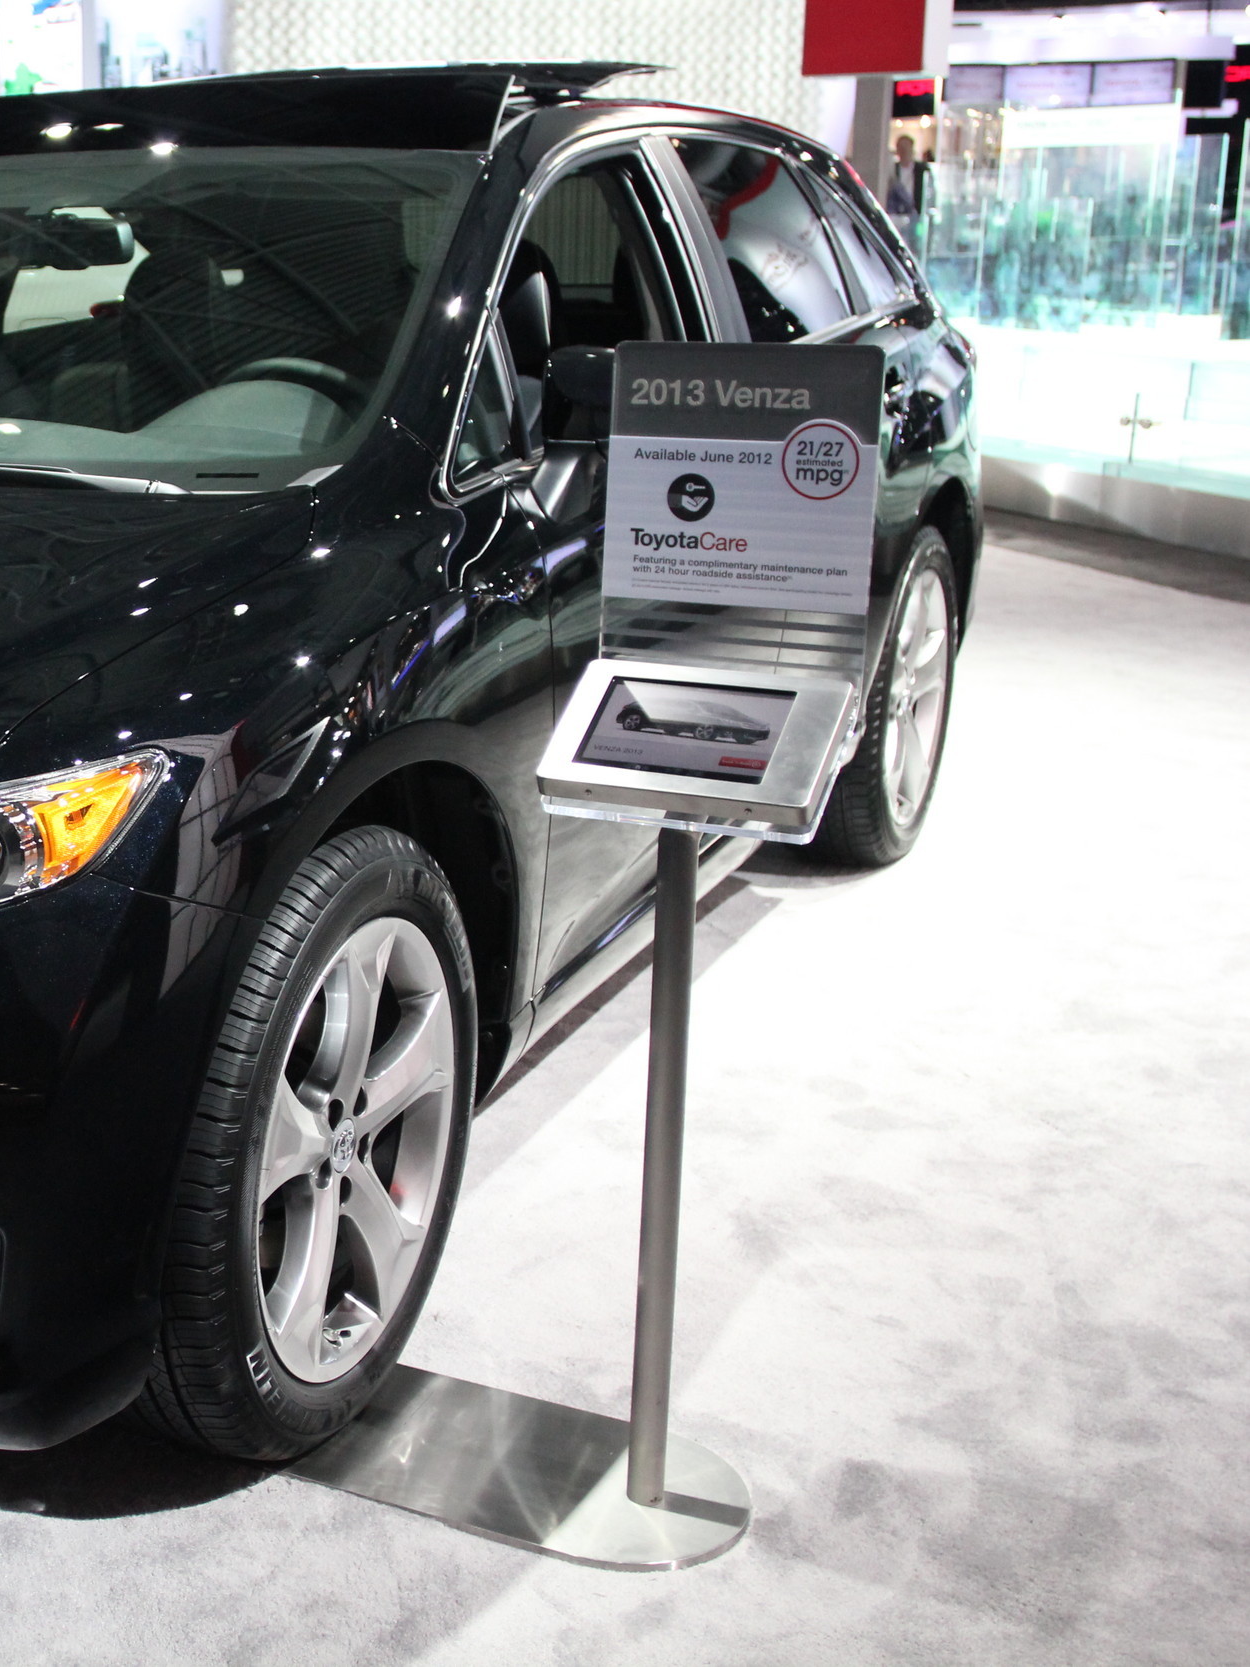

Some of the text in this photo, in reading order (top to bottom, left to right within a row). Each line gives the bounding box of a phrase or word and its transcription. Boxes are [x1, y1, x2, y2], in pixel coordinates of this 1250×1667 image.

[631, 378, 811, 410] 2013 Venza
[634, 448, 772, 465] Available June 2012
[797, 440, 844, 458] 21/27
[796, 459, 844, 467] estimated
[630, 528, 748, 552] ToyotaCare
[632, 565, 788, 583] with 24 hour roadside assistance
[633, 554, 677, 567] Featuring
[688, 558, 758, 573] complimentary
[761, 563, 824, 575] maintenance
[826, 568, 848, 577] plan
